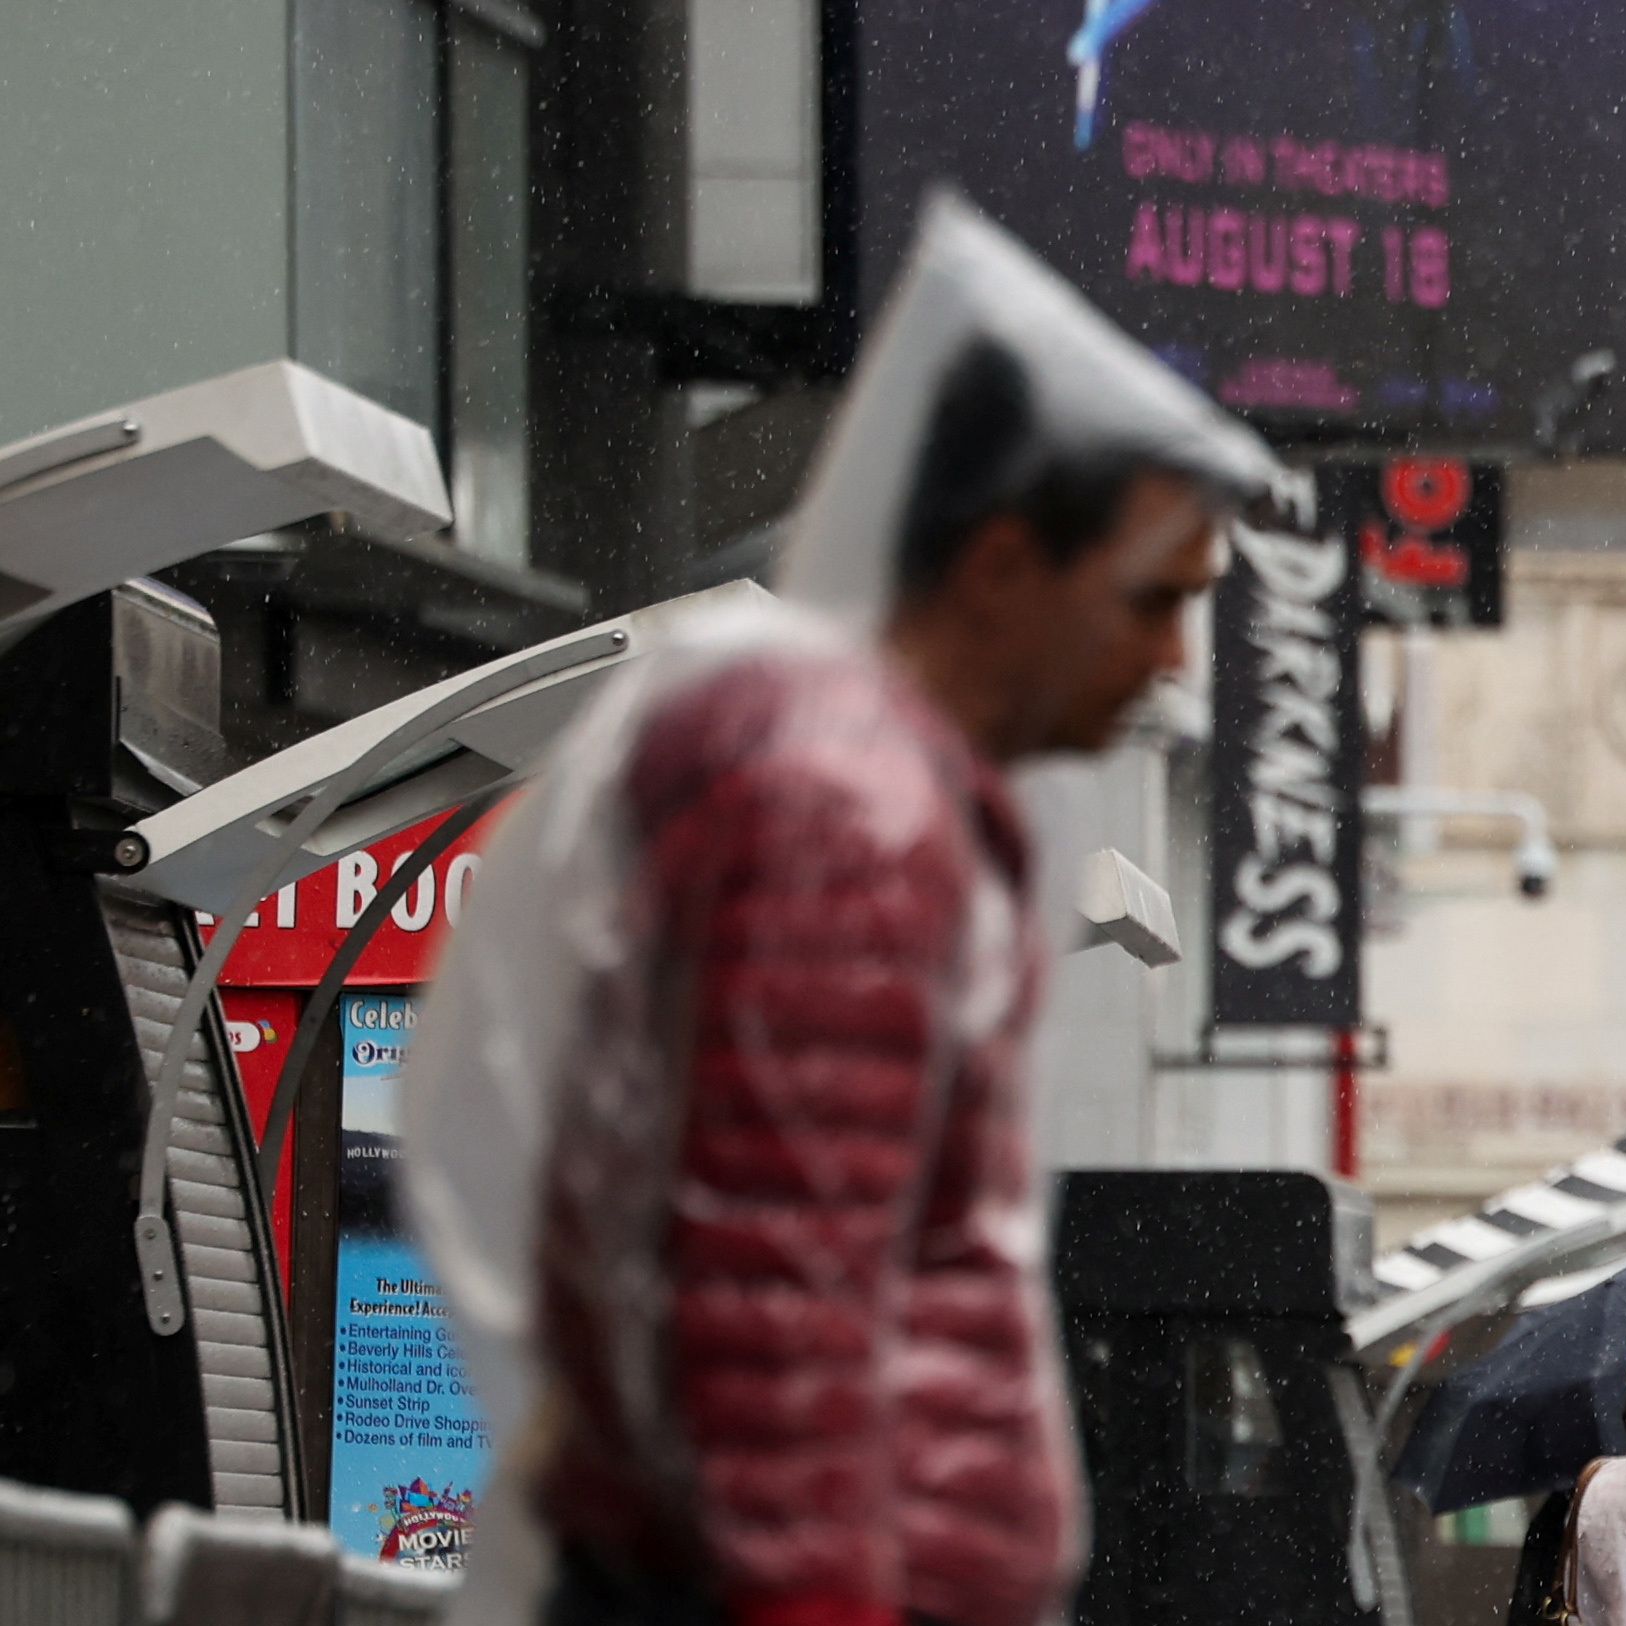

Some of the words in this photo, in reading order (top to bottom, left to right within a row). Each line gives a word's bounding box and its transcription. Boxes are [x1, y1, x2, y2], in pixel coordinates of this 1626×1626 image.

[1126, 200, 1360, 296] AUGUST
[1382, 225, 1450, 308] 18
[376, 1277, 398, 1295] The
[350, 1298, 419, 1317] Experience!
[349, 1323, 431, 1343] Entertaining
[349, 1341, 399, 1360] Beverly
[403, 1343, 433, 1359] Hills
[347, 1359, 412, 1376] Historical
[416, 1362, 442, 1377] and
[346, 1377, 422, 1394] Mulholland
[426, 1380, 445, 1395] Dr.
[345, 1394, 393, 1411] Sunset
[397, 1396, 430, 1414] Strip
[344, 1411, 390, 1428] Rodeo
[394, 1413, 431, 1430] Drive
[343, 1429, 396, 1446] Dozens
[399, 1432, 414, 1447] of
[417, 1432, 443, 1448] film
[446, 1435, 473, 1450] and
[398, 1529, 472, 1552] MOVIE
